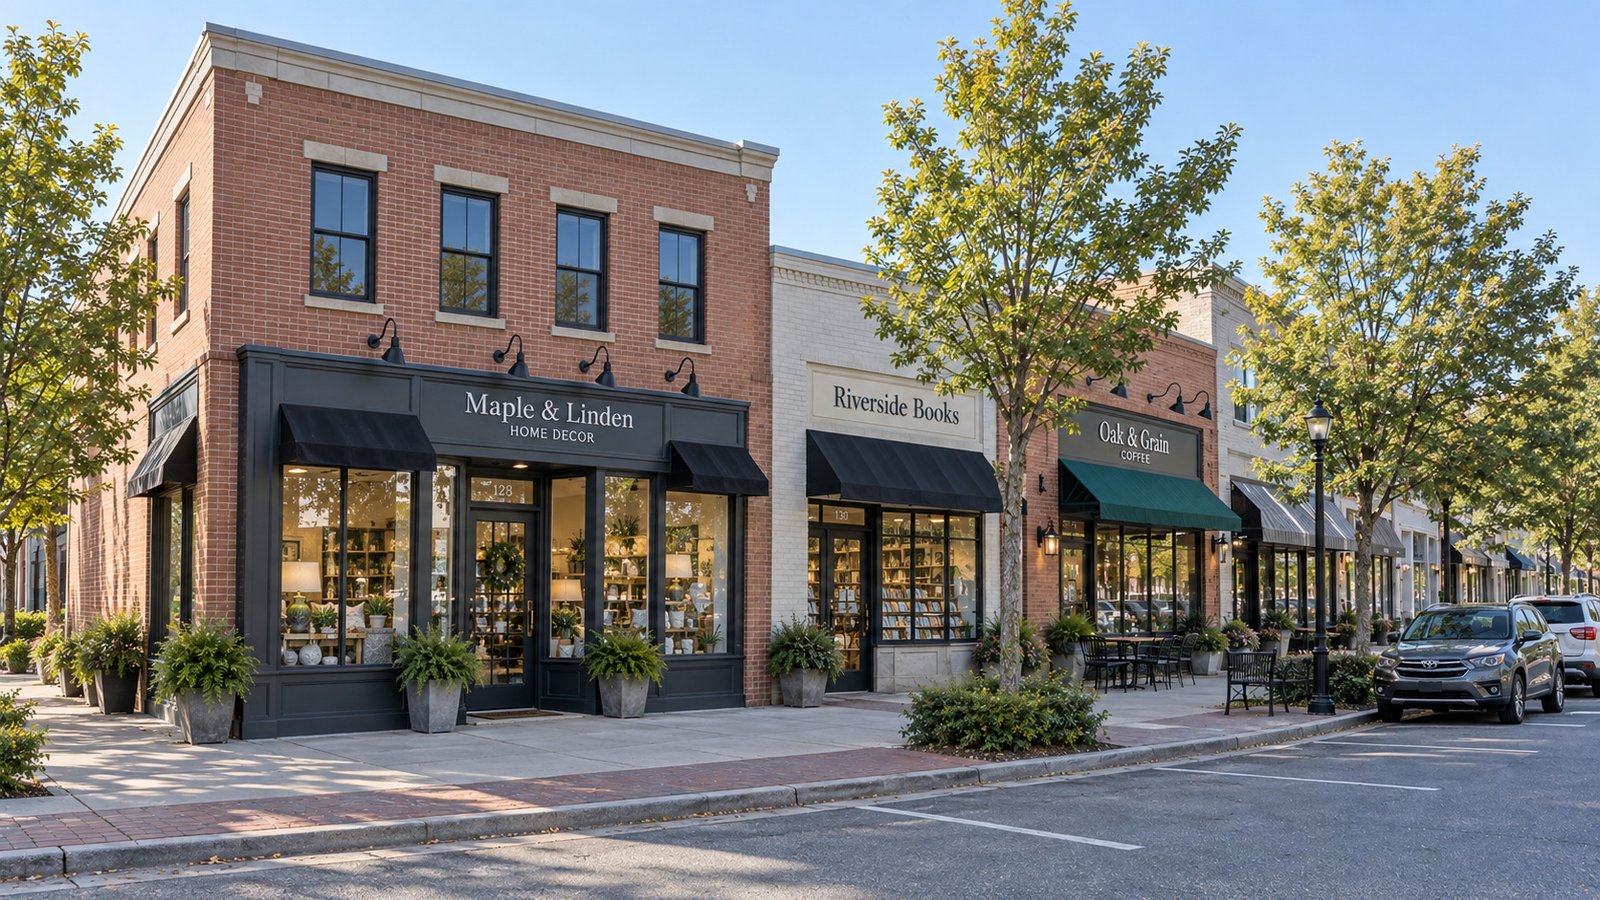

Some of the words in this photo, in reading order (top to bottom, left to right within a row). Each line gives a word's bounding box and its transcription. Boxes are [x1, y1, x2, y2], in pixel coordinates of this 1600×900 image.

[465, 392, 534, 423] Maple
[541, 400, 559, 421] &
[567, 402, 634, 428] Linden
[833, 385, 907, 416] Riverside
[913, 398, 959, 425] Books
[510, 425, 547, 439] HOME
[553, 429, 594, 443] DECOR
[1099, 421, 1124, 445] Oak
[1127, 427, 1137, 448] &
[1141, 429, 1169, 454] Grain
[1121, 450, 1150, 464] COFFEE
[494, 484, 512, 496] 128
[835, 510, 848, 520] 130
